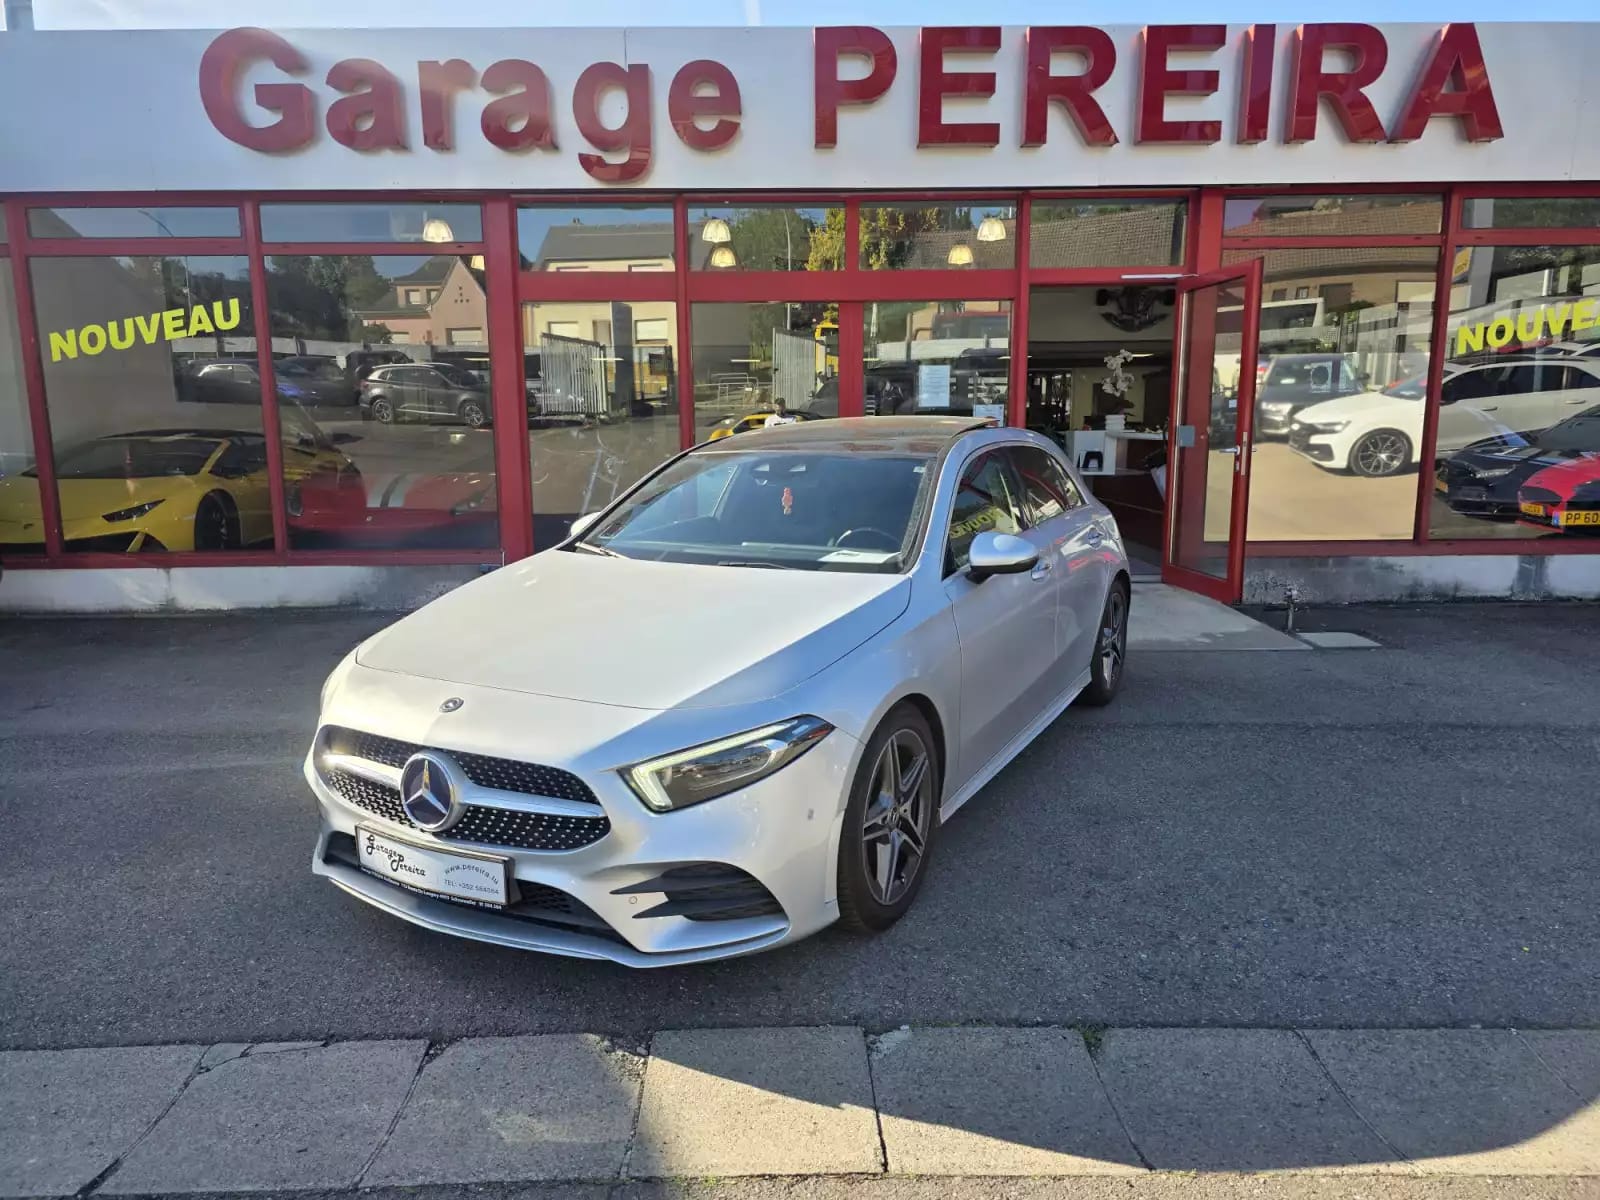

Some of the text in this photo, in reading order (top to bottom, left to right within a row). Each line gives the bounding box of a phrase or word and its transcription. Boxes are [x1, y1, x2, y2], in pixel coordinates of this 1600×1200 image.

[198, 22, 1505, 183] Garage PEREIRA
[49, 297, 241, 362] NOUVEAU
[1457, 298, 1600, 354] NOUVE
[1566, 512, 1600, 524] PP 60
[366, 834, 398, 861] Garage
[390, 853, 427, 877] Pereira
[444, 863, 499, 885] www.pereira.lu
